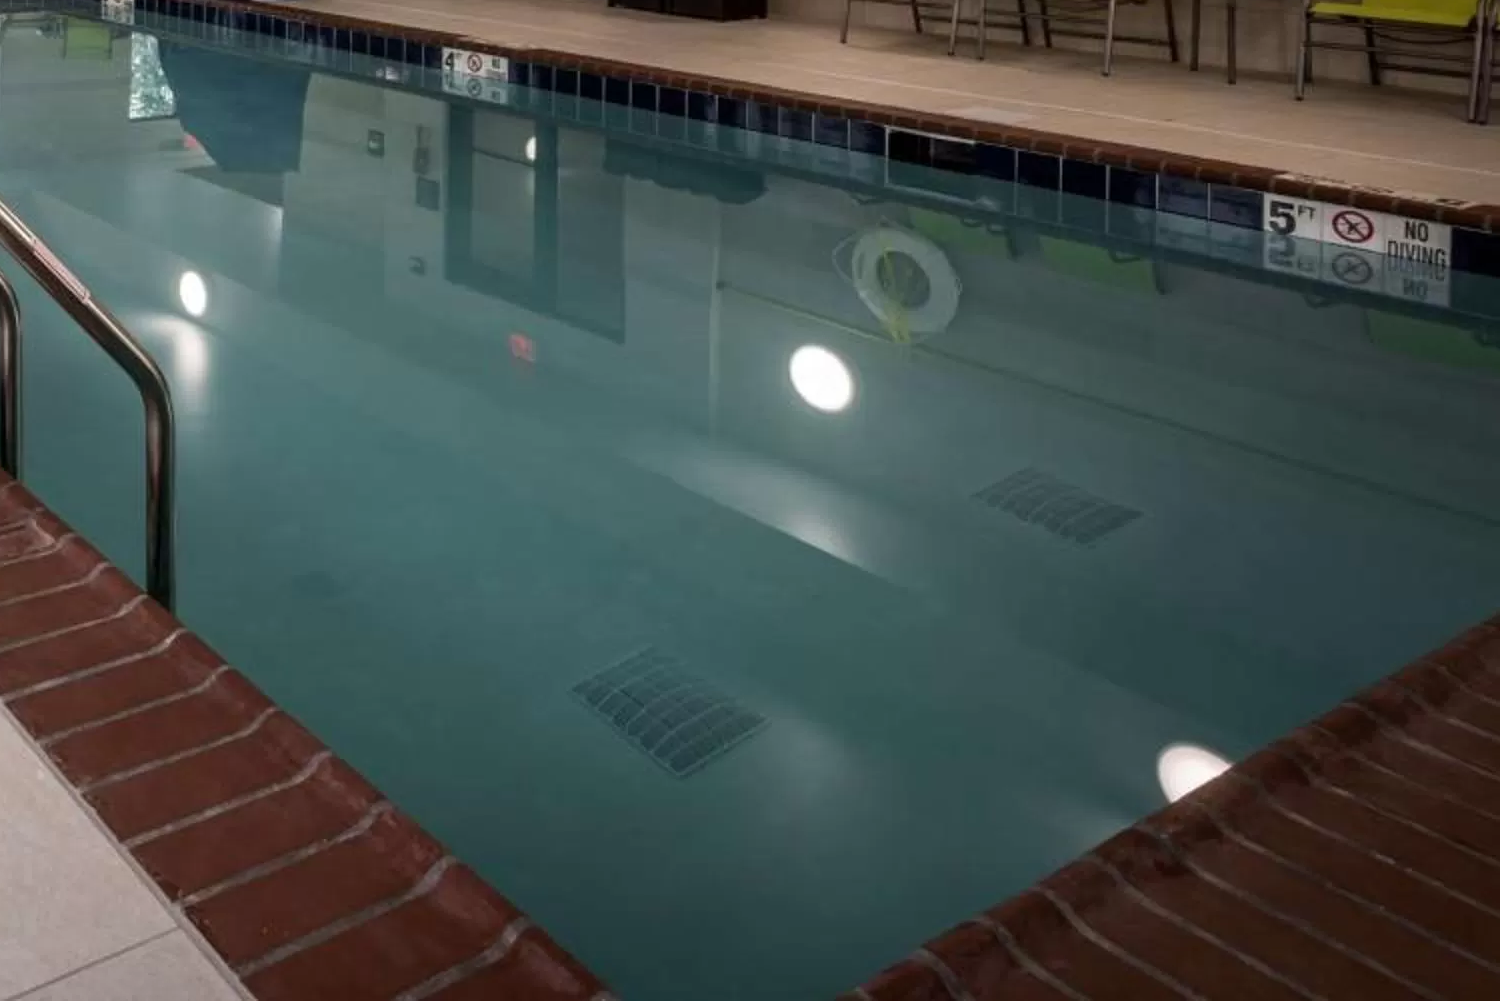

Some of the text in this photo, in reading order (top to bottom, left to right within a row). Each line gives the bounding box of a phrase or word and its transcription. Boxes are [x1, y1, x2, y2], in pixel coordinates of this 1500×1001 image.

[1268, 200, 1317, 236] 5 FT
[1404, 220, 1429, 242] NO
[1387, 240, 1447, 269] DIVING
